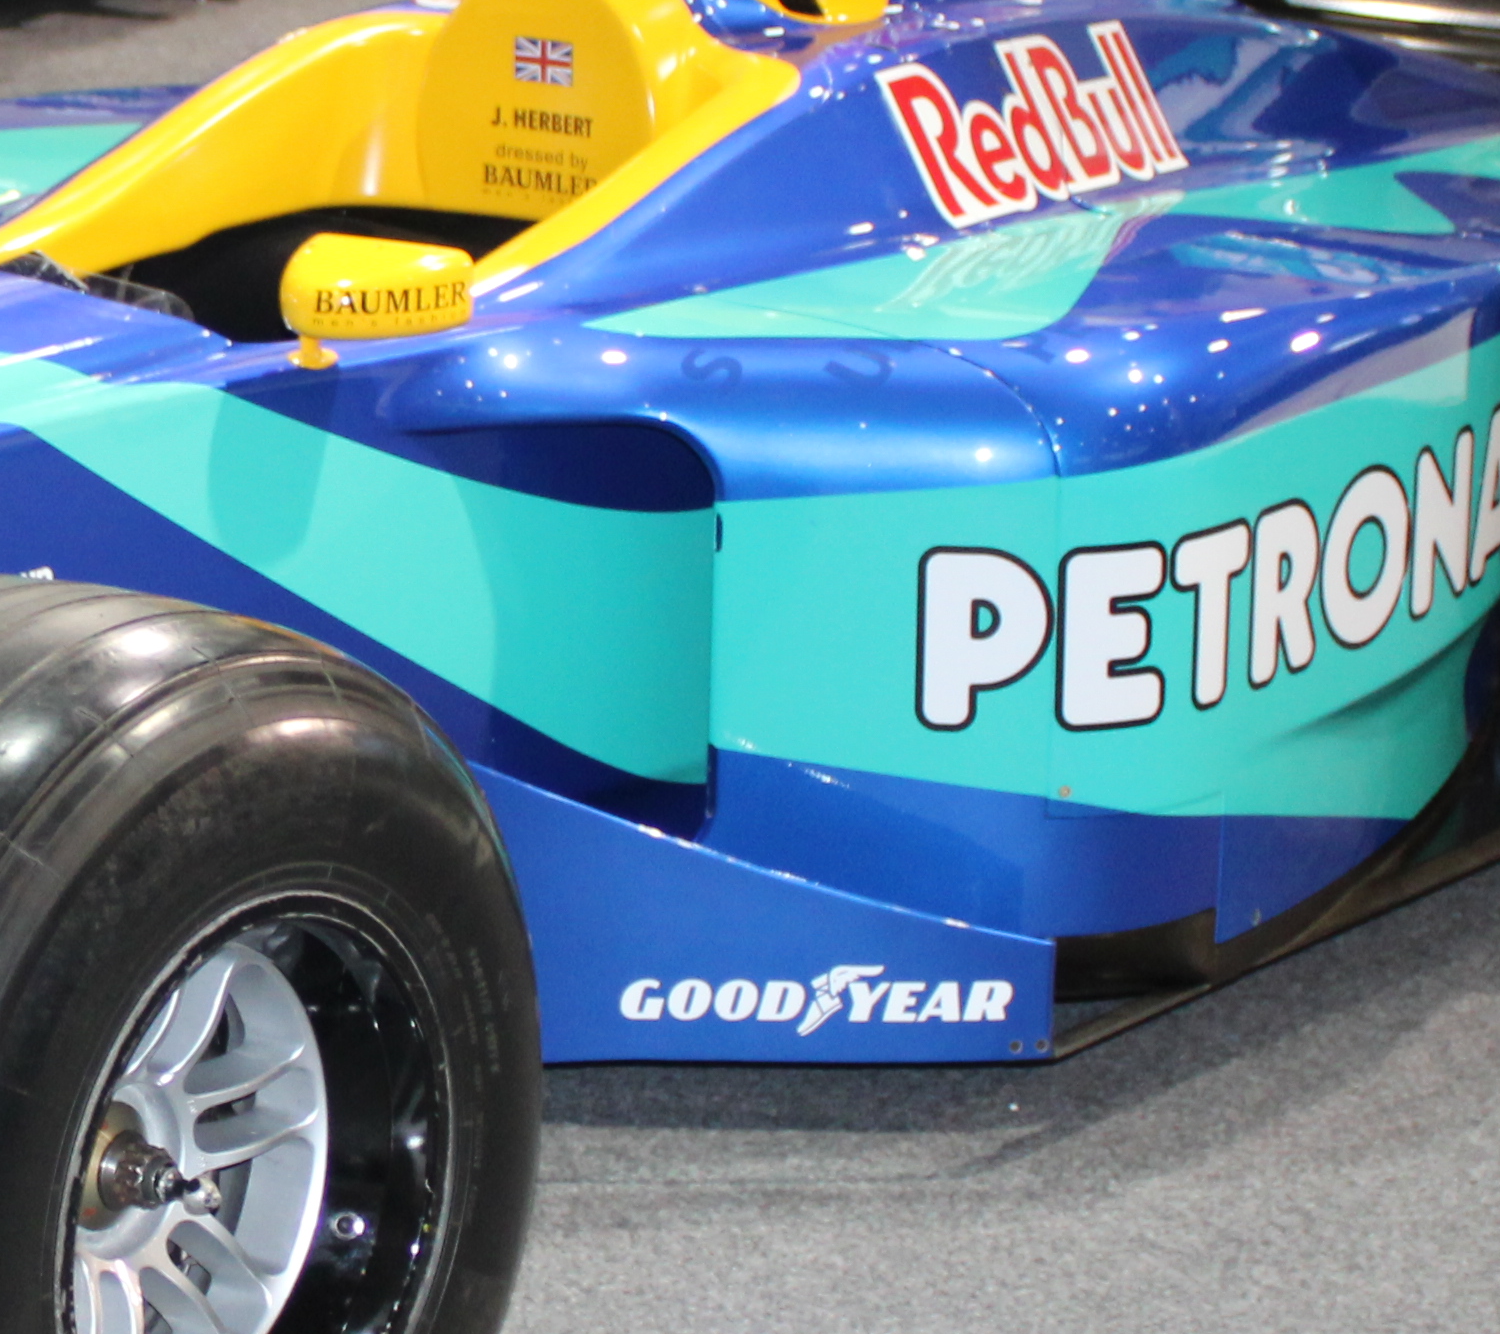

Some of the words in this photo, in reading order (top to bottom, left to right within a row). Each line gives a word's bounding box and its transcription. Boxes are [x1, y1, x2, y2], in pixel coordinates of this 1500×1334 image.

[491, 107, 508, 128] J.
[514, 109, 594, 139] HERBERT
[495, 145, 564, 167] dressed
[571, 150, 589, 173] by
[619, 972, 1014, 1027] GOODYEAR
